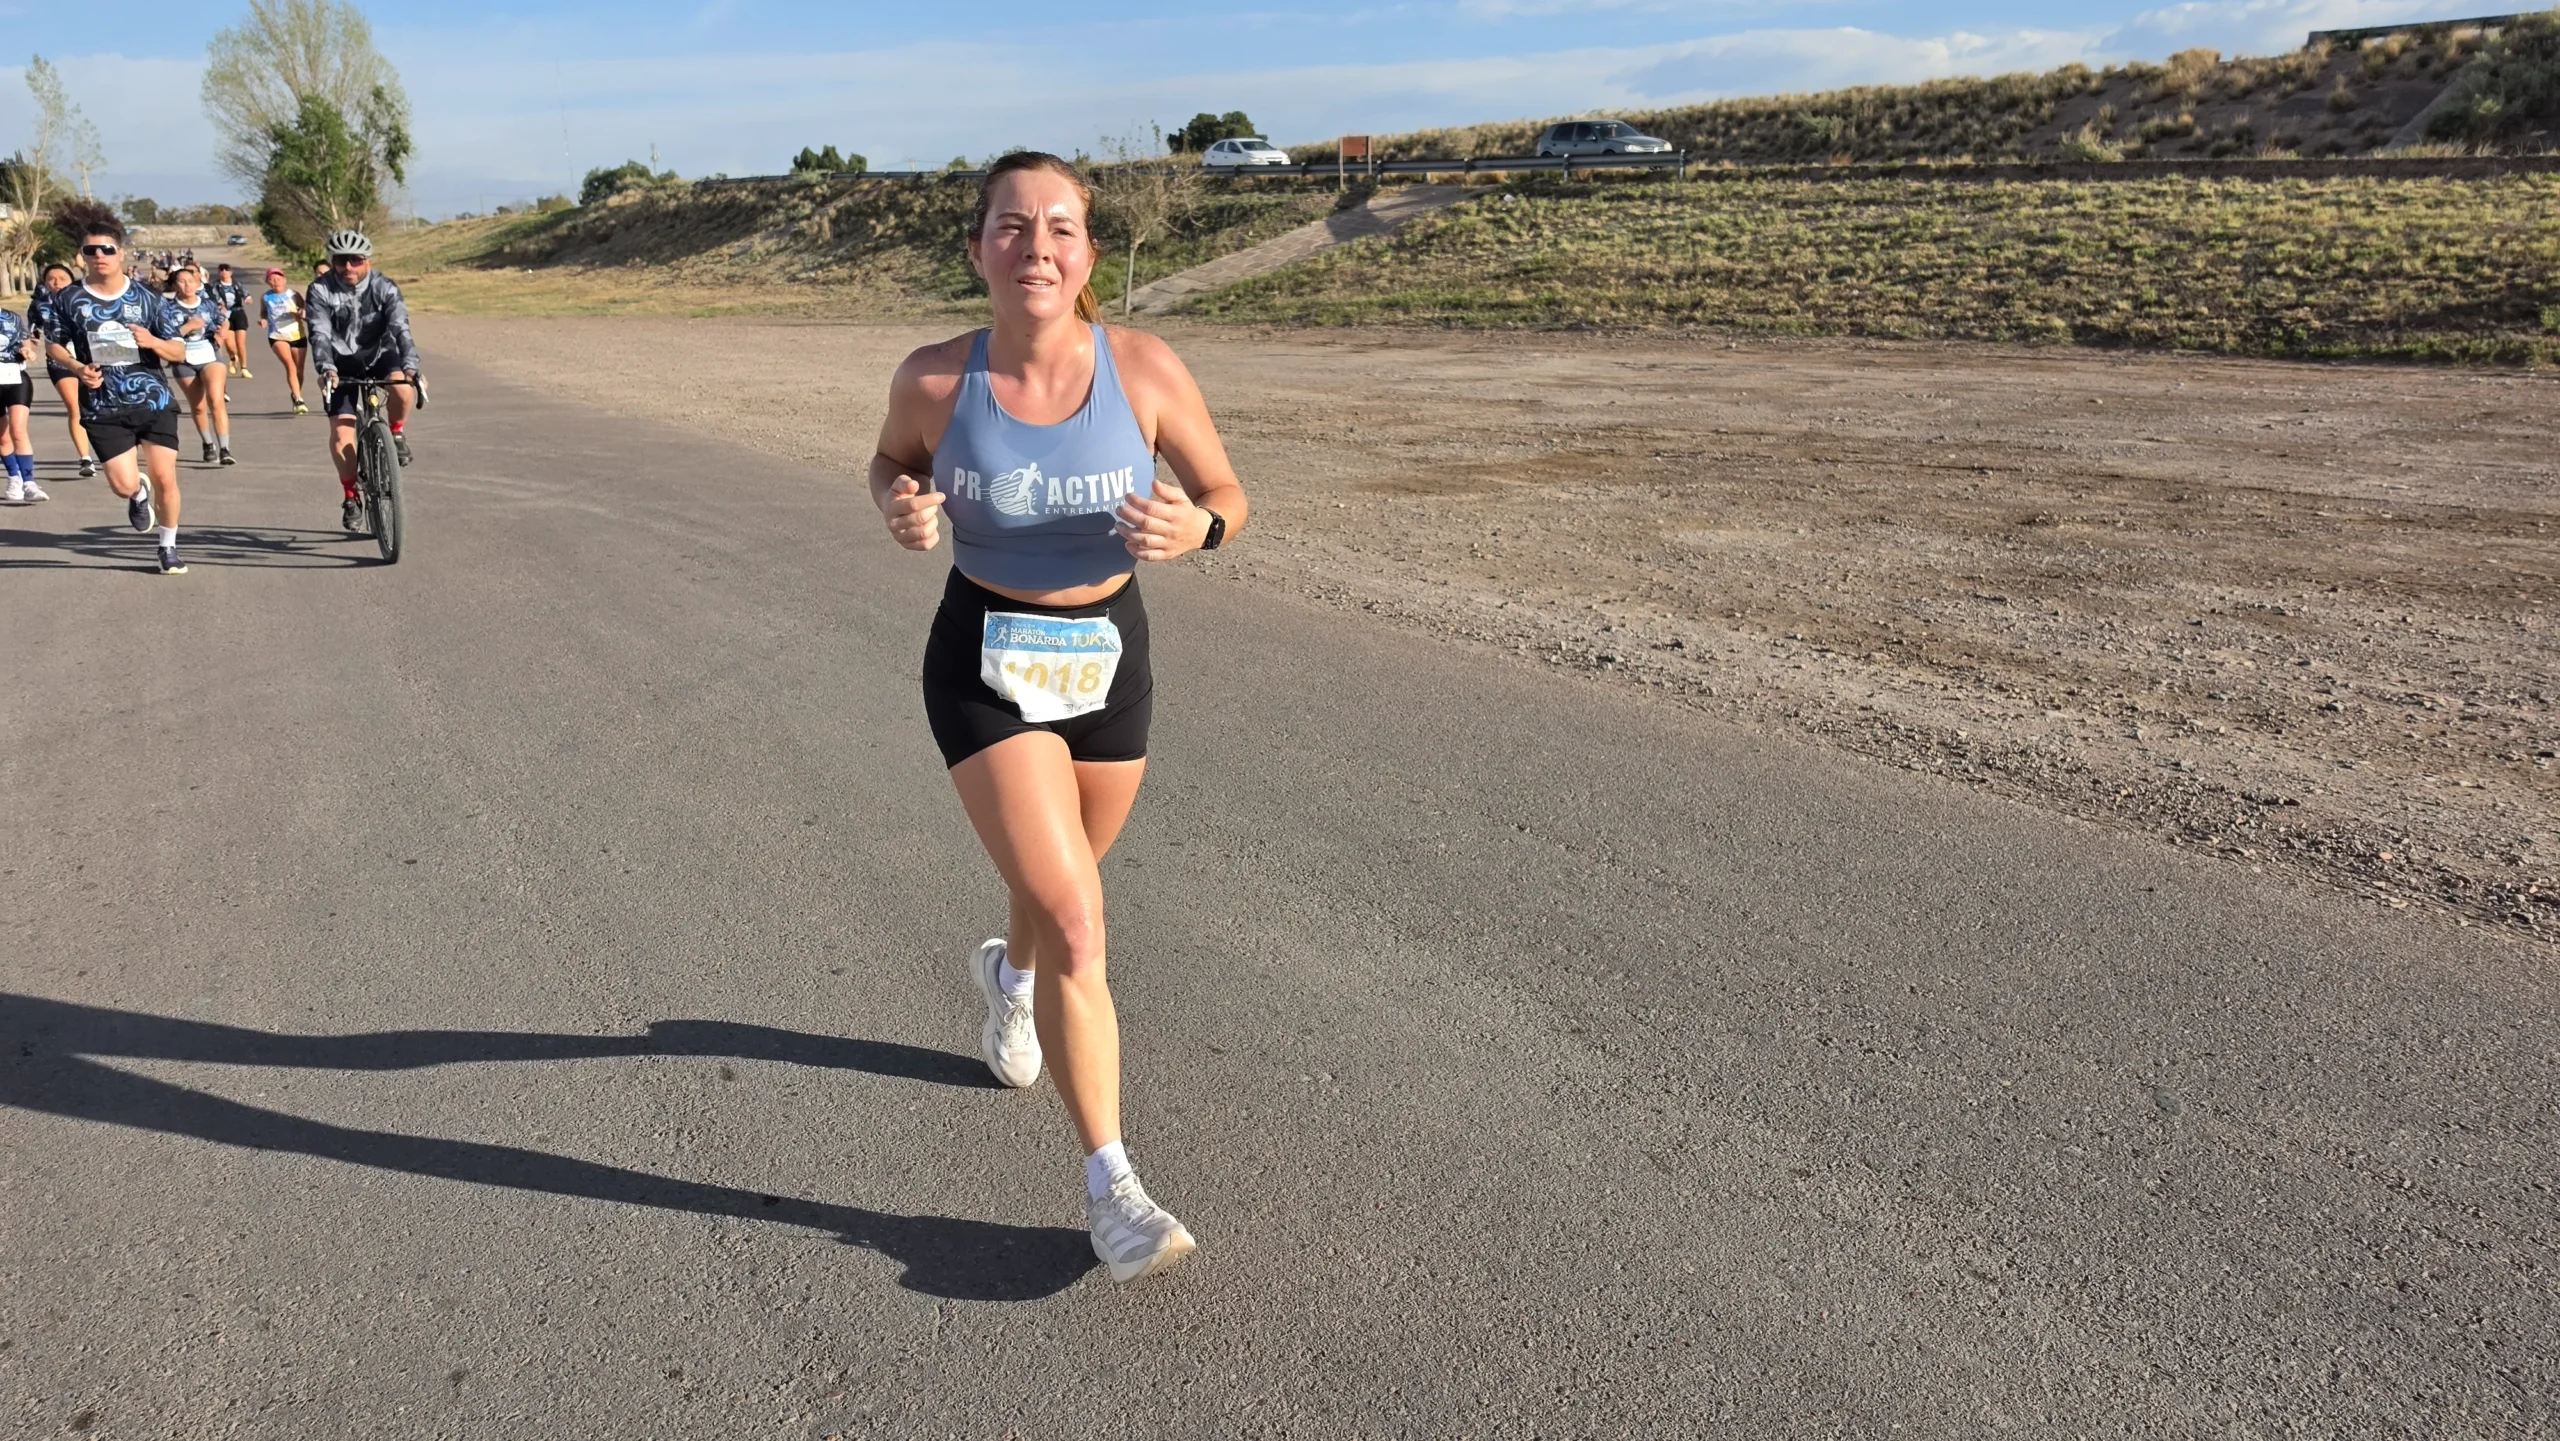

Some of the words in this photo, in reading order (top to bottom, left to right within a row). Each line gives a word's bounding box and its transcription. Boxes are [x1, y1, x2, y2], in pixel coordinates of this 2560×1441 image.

[1046, 465, 1135, 506] ACTIVE
[1045, 499, 1127, 515] ENTRENAMIEN
[1010, 633, 1067, 646] BONARDA
